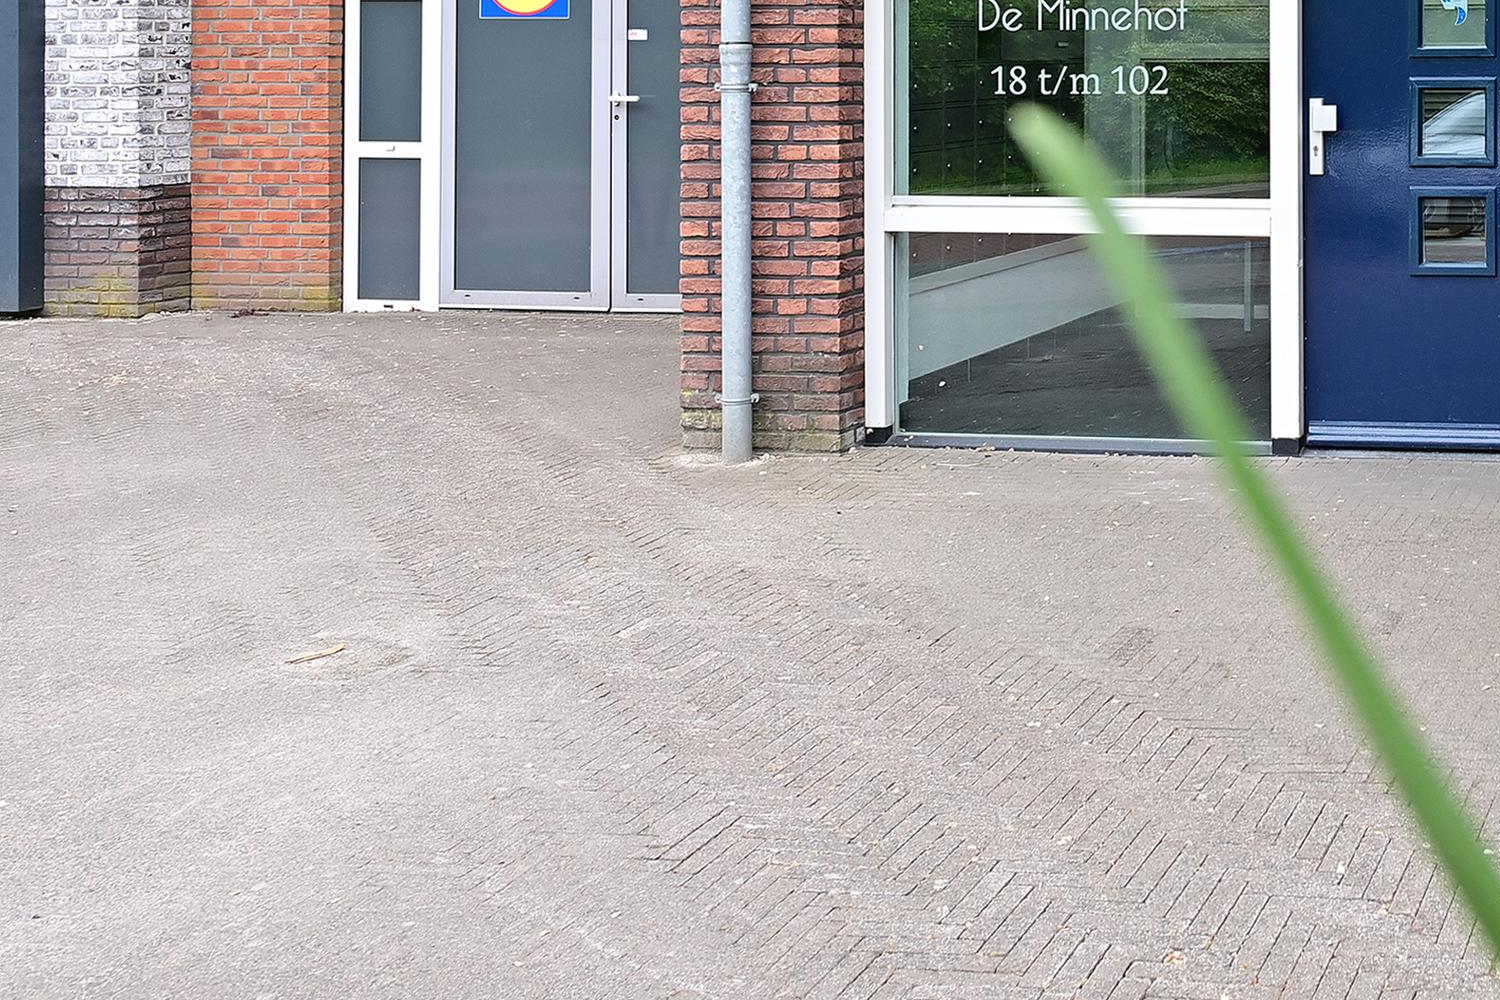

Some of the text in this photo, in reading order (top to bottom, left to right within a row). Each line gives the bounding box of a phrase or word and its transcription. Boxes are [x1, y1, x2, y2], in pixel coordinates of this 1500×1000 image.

[990, 65, 1169, 96] 18 t/m 102
